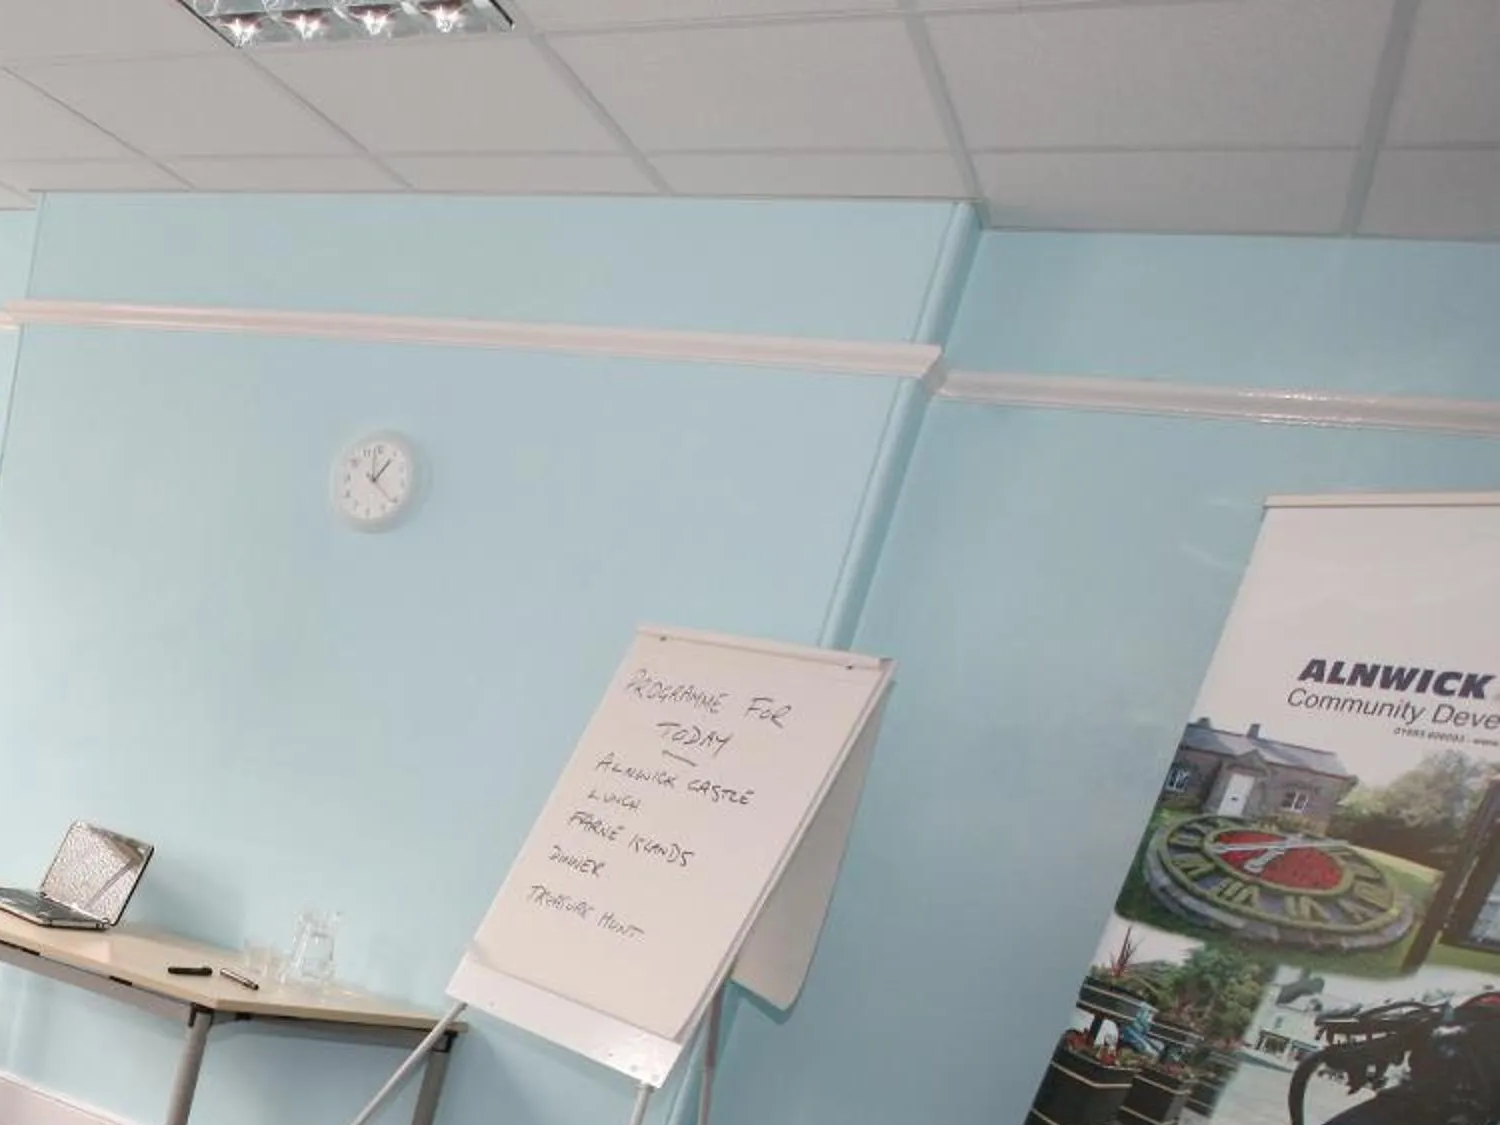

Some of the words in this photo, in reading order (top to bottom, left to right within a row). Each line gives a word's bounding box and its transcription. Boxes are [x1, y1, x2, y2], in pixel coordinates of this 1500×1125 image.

[1297, 658, 1496, 700] ALNWICK
[1287, 687, 1426, 726] Community
[656, 721, 735, 759] TODAY
[595, 751, 678, 788] ALNWICK
[687, 778, 756, 805] CASTLE
[587, 789, 642, 810] LUNCH
[567, 810, 625, 842] FARNE
[628, 833, 696, 867] ISLANDS
[547, 844, 606, 878] DINNER
[597, 911, 645, 937] HUNT
